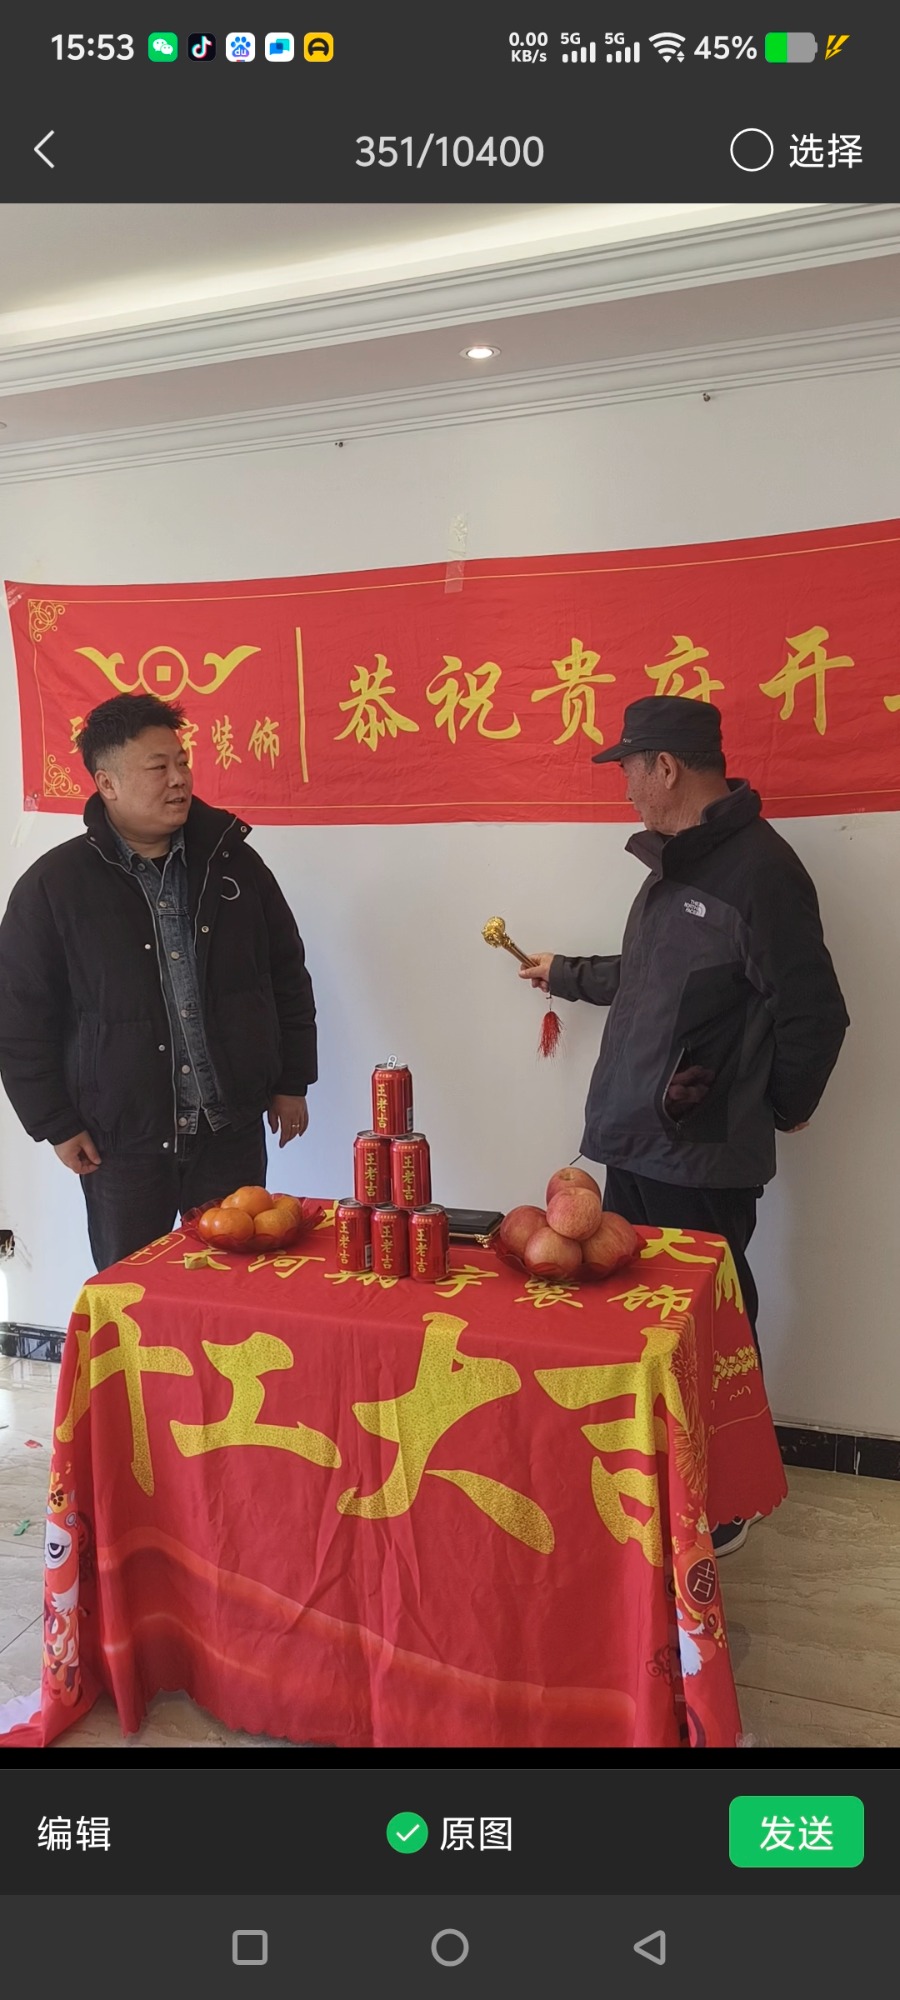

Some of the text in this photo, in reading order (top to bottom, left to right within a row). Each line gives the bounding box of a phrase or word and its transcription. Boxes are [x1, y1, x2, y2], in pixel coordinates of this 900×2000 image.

[333, 626, 900, 752] 恭祝贵府开
[377, 1083, 388, 1129] 王老吉
[365, 1152, 378, 1197] 王老吉
[402, 1155, 415, 1201] 王老吉
[339, 1220, 350, 1265] 王老吉
[381, 1225, 394, 1270] 王老吉
[416, 1228, 428, 1274] 王老吉
[56, 1283, 690, 1567] 开工大吉
[692, 1561, 715, 1599] 吉
